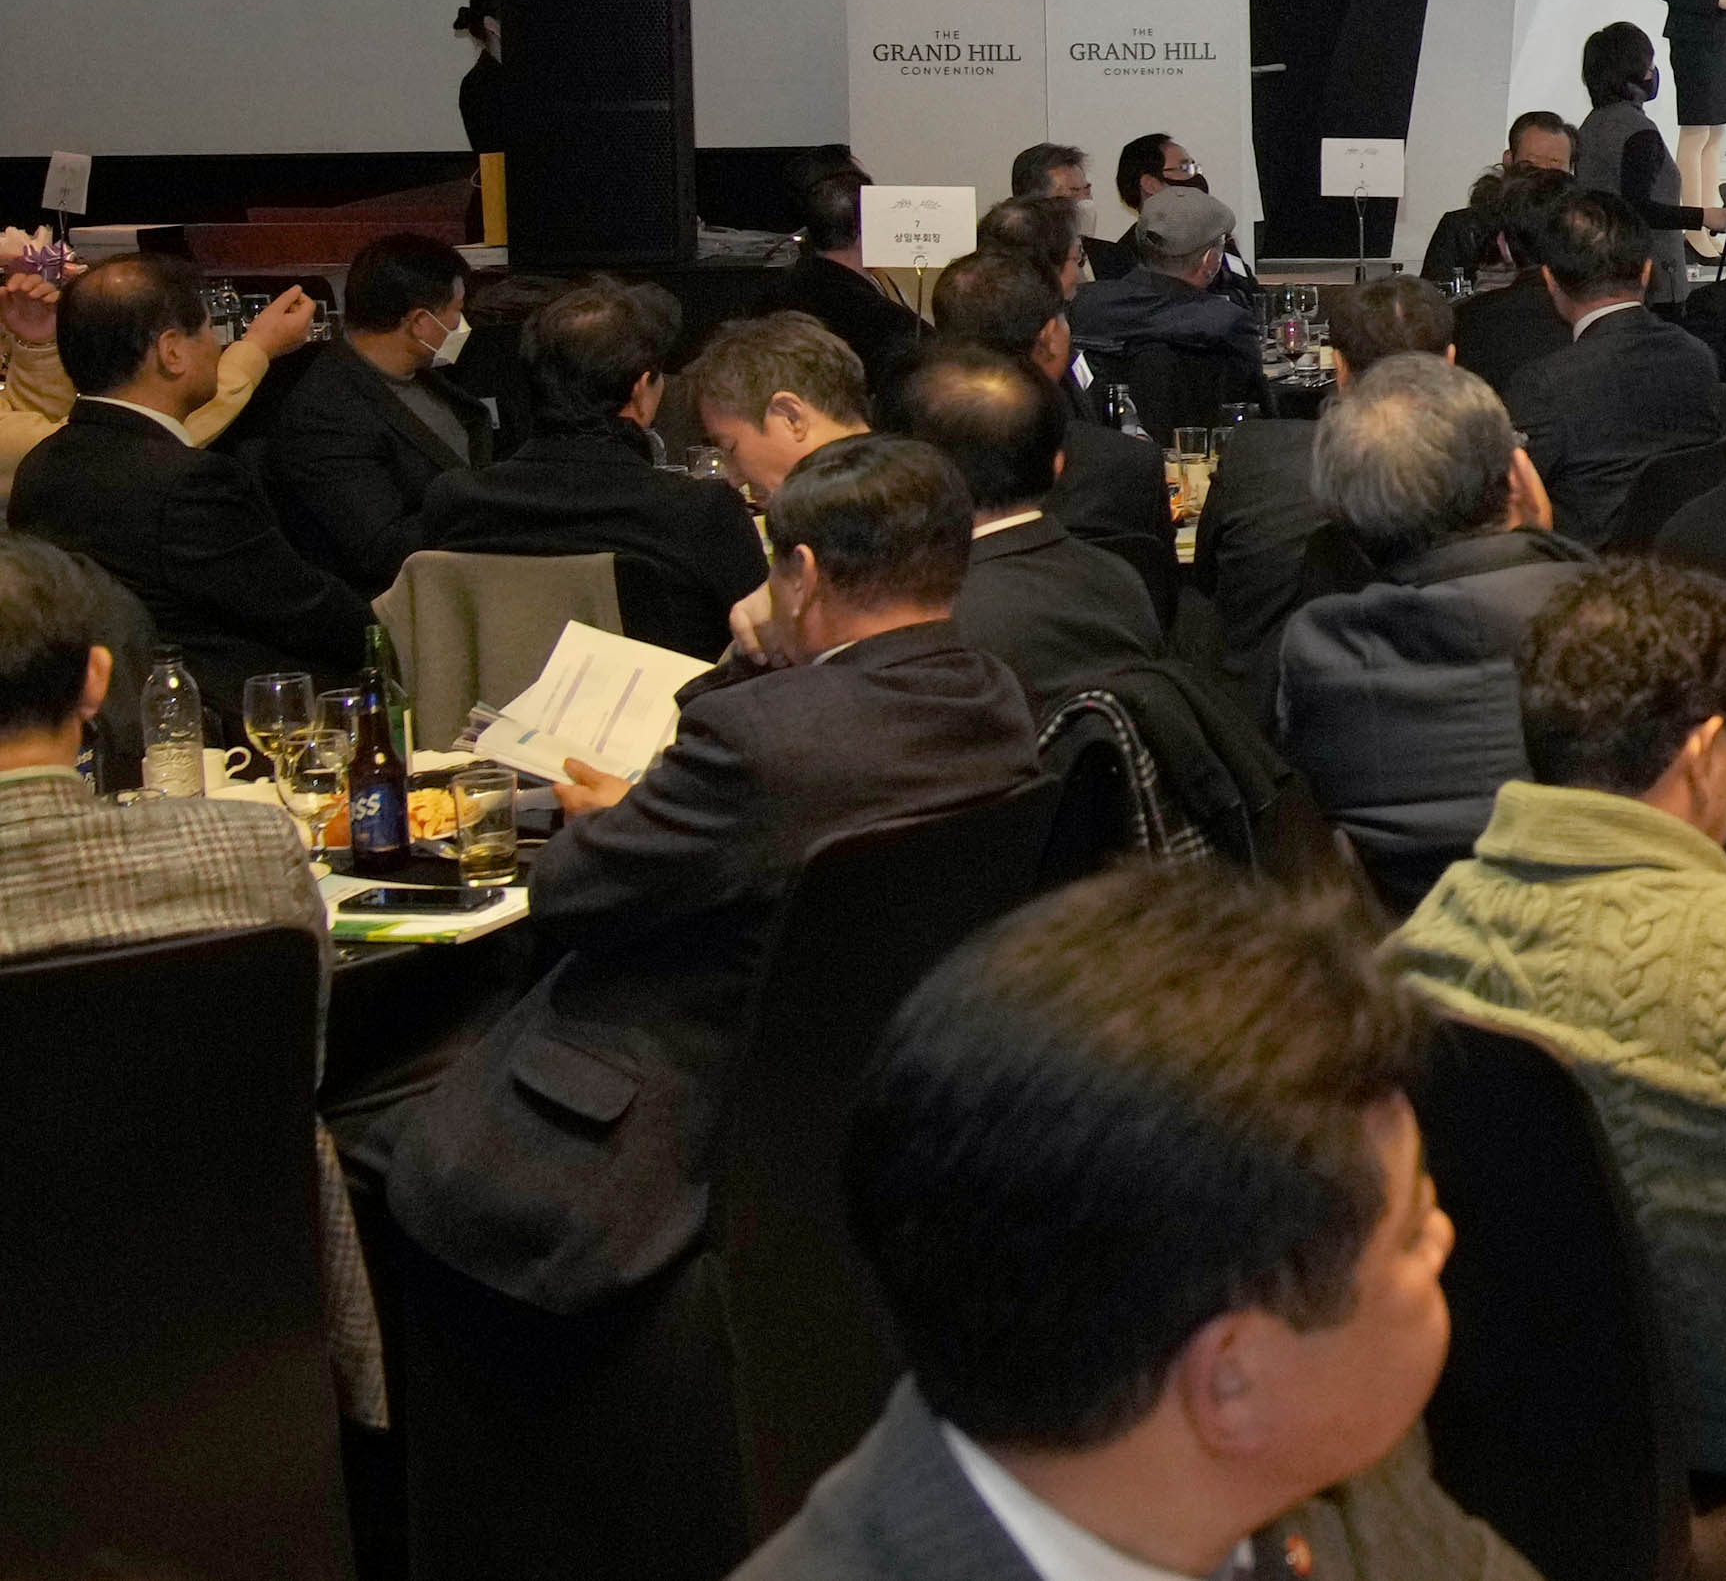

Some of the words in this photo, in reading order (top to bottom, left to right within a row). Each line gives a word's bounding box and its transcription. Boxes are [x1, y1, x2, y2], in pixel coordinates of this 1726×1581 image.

[935, 30, 960, 40] THE
[1132, 28, 1153, 37] THE
[872, 43, 961, 62] GRAND
[967, 43, 1021, 62] HILL
[1069, 42, 1156, 61] GRAND
[1164, 42, 1216, 61] HILL
[900, 66, 994, 76] CONVENTION
[1103, 67, 1184, 76] CONVENTION
